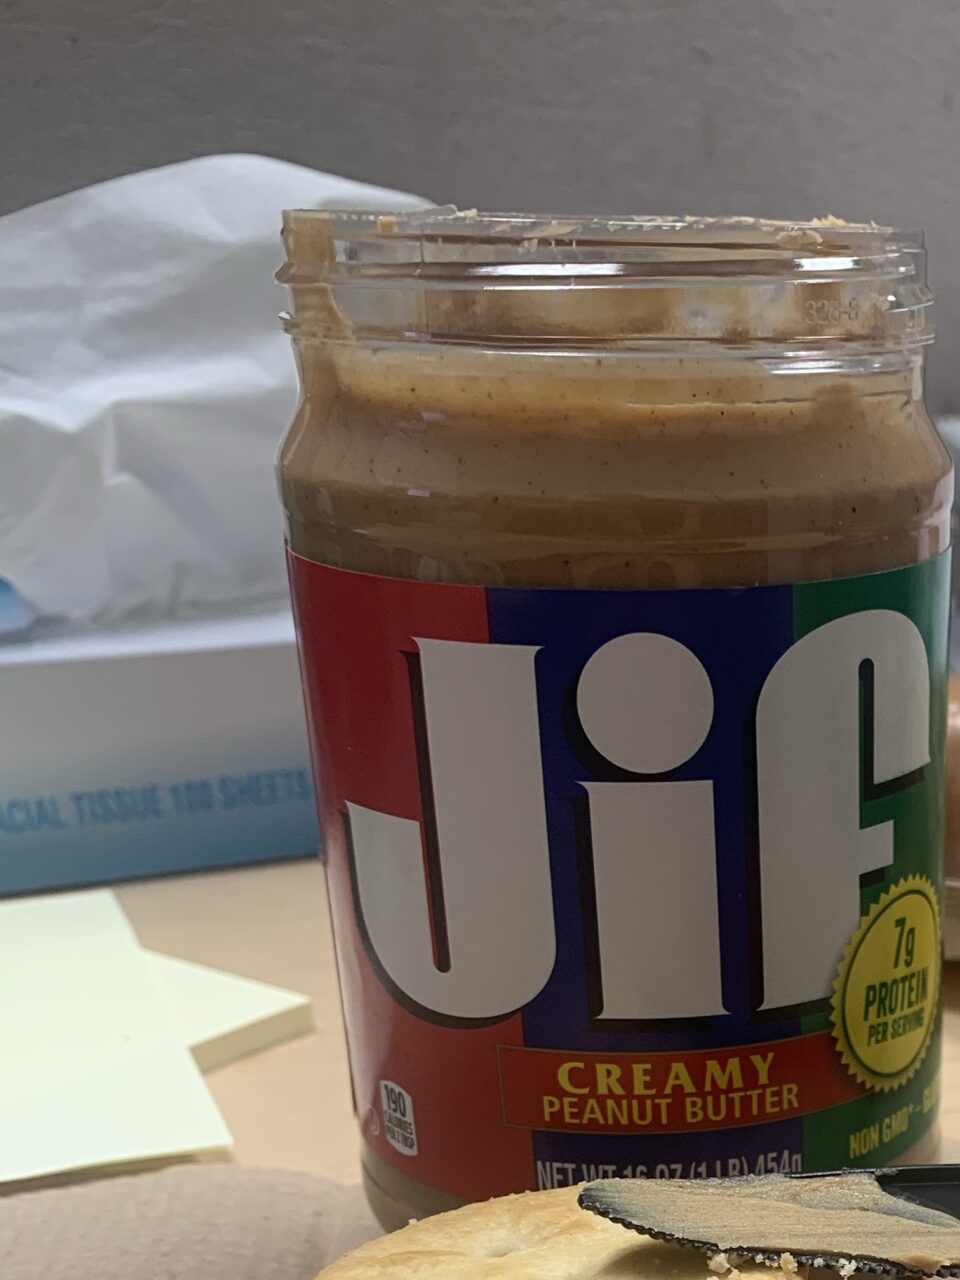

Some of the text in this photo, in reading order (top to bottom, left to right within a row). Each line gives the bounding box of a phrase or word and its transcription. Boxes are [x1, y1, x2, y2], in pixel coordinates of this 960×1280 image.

[70, 783, 163, 825] TISSUE
[218, 767, 312, 811] SHEETS
[344, 608, 931, 1020] Jif
[893, 917, 916, 969] 7g
[864, 966, 929, 1022] PROTEIN
[867, 1007, 925, 1047] PER SERVING
[557, 1052, 775, 1095] CREAMY
[384, 1084, 407, 1118] 190
[542, 1083, 800, 1126] PEANUT BUTTER
[849, 1122, 880, 1159] NON
[536, 1160, 576, 1191] NET
[581, 1164, 618, 1187] WT
